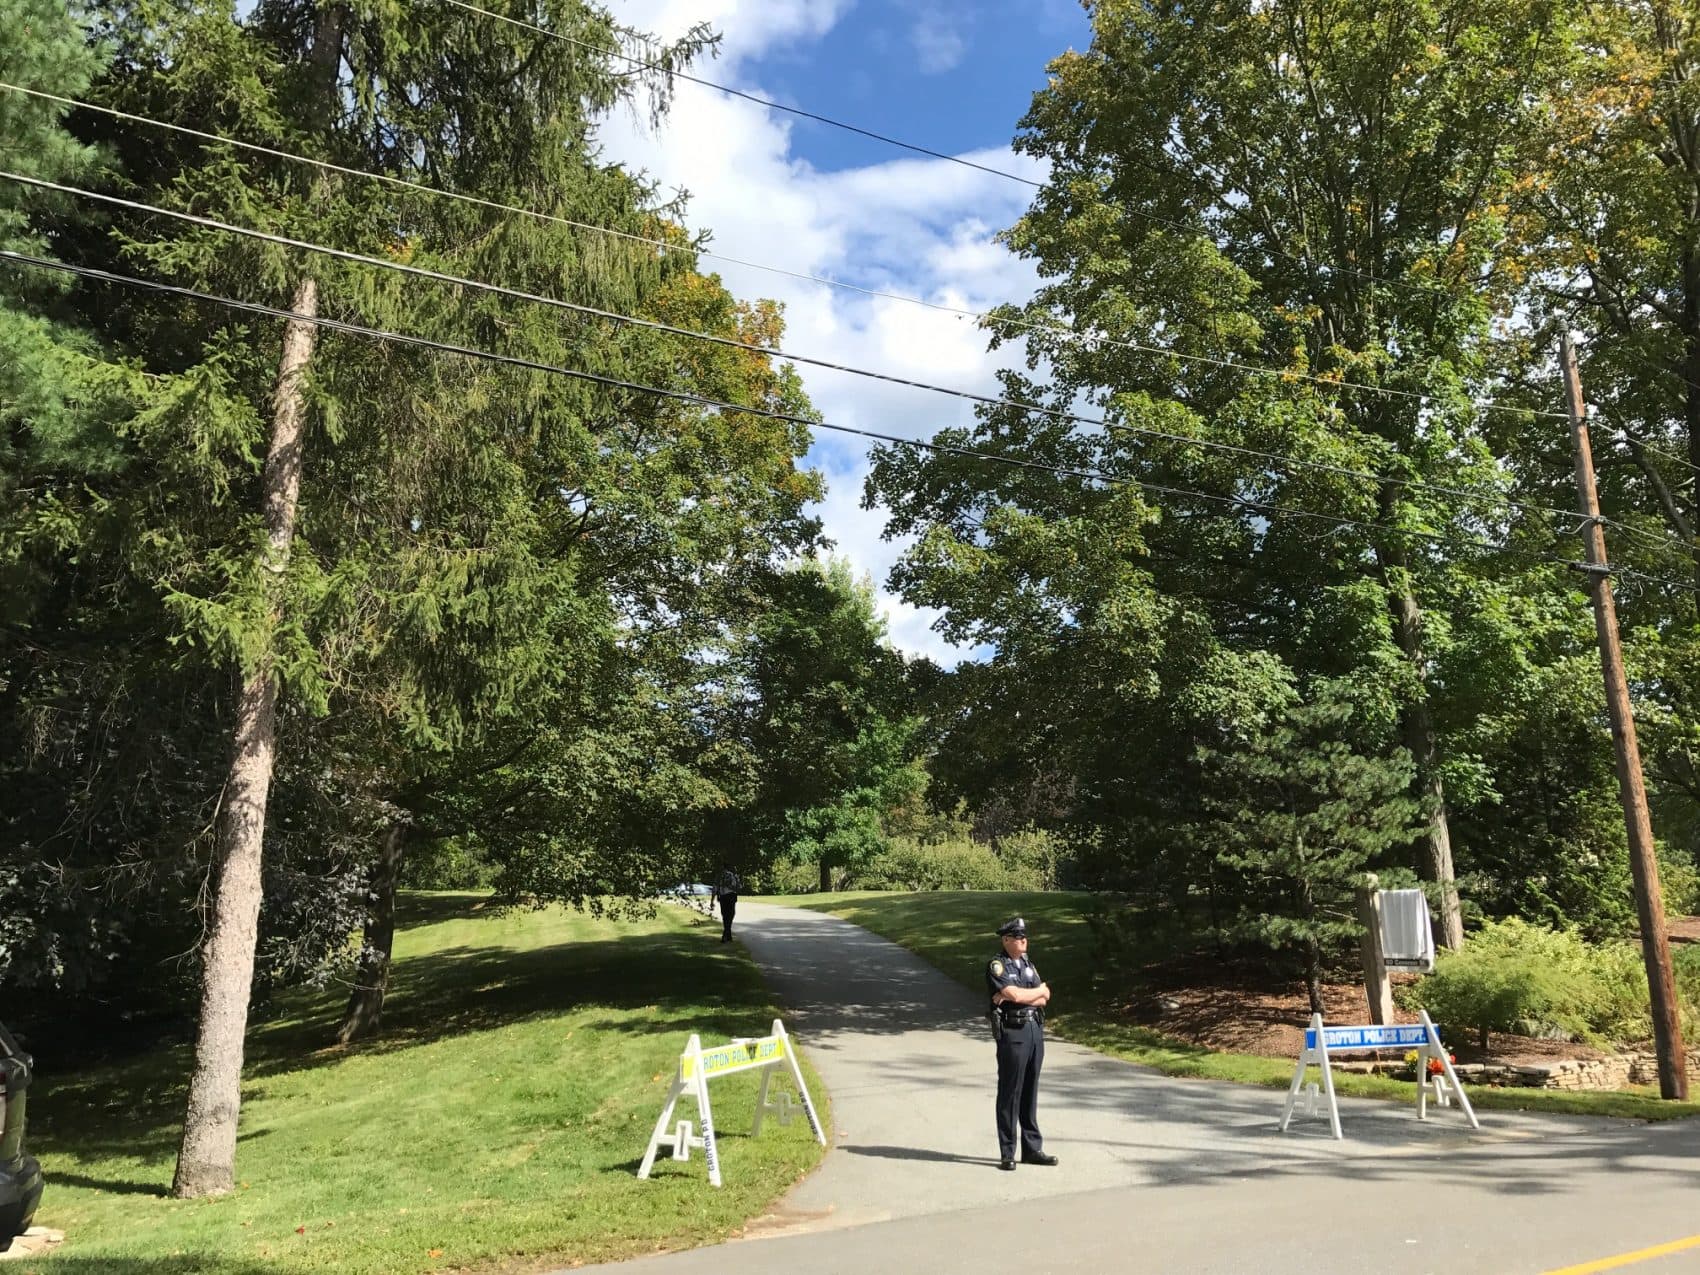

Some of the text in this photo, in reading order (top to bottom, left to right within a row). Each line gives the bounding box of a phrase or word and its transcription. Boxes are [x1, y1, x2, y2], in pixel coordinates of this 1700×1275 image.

[1363, 1028, 1397, 1044] POLICE
[1398, 1026, 1427, 1043] DEPT.
[703, 1052, 729, 1071] ROTON
